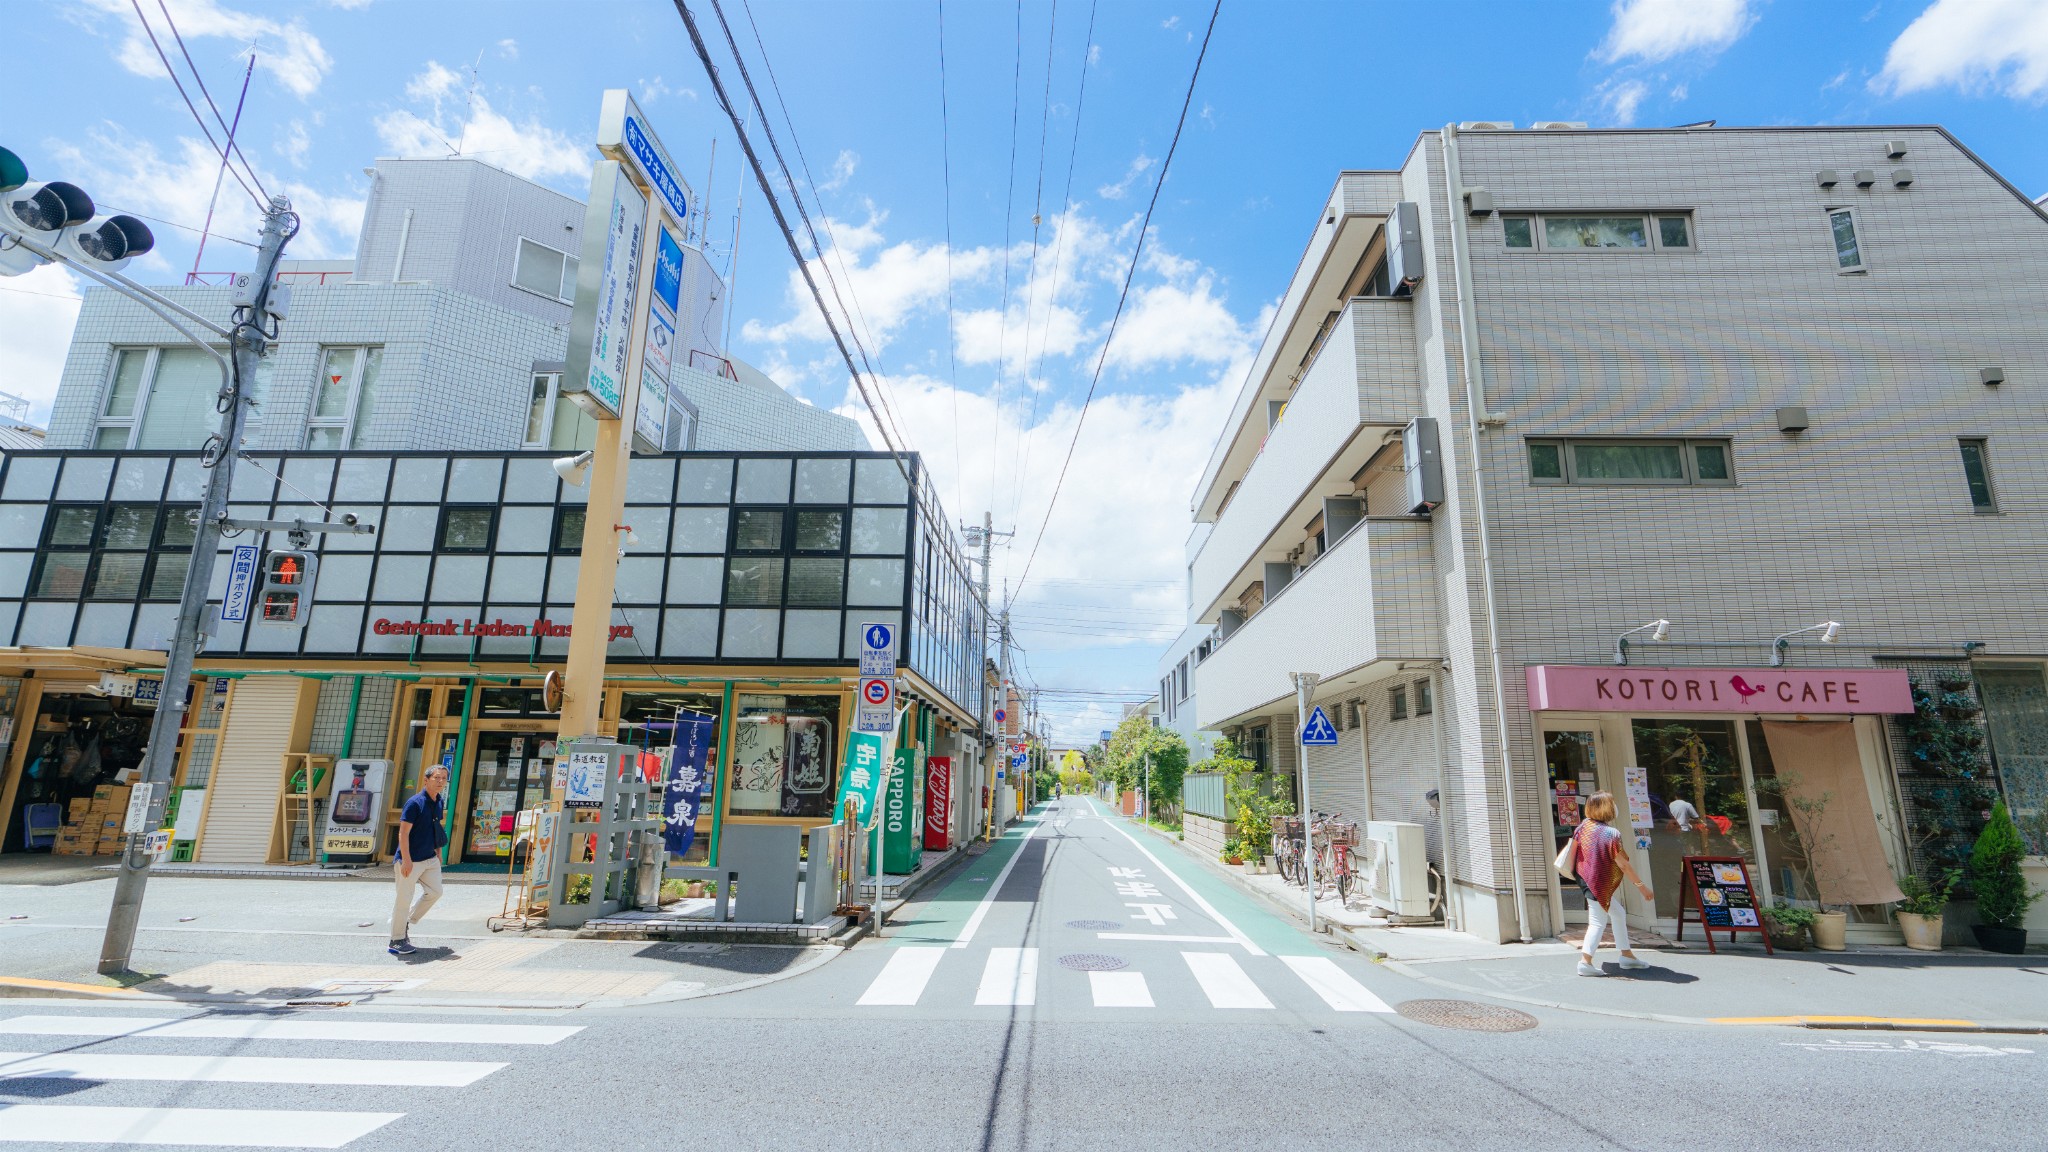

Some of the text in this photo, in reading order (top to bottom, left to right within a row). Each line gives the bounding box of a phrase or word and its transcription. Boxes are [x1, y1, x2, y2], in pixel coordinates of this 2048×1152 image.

[659, 248, 680, 282] Asahi
[590, 375, 620, 407] 47-5085
[229, 549, 253, 618] 夜間押ボタン式
[463, 619, 525, 636] Laden
[531, 619, 634, 642] Masya
[138, 680, 156, 698] 米
[1596, 678, 1860, 703] KOTORI CAFE
[573, 754, 606, 764] 柔道教室
[666, 765, 702, 826] 嘉泉
[887, 756, 905, 833] SAPPORO
[928, 759, 947, 834] Coca-Cola
[542, 816, 552, 837] ゆう
